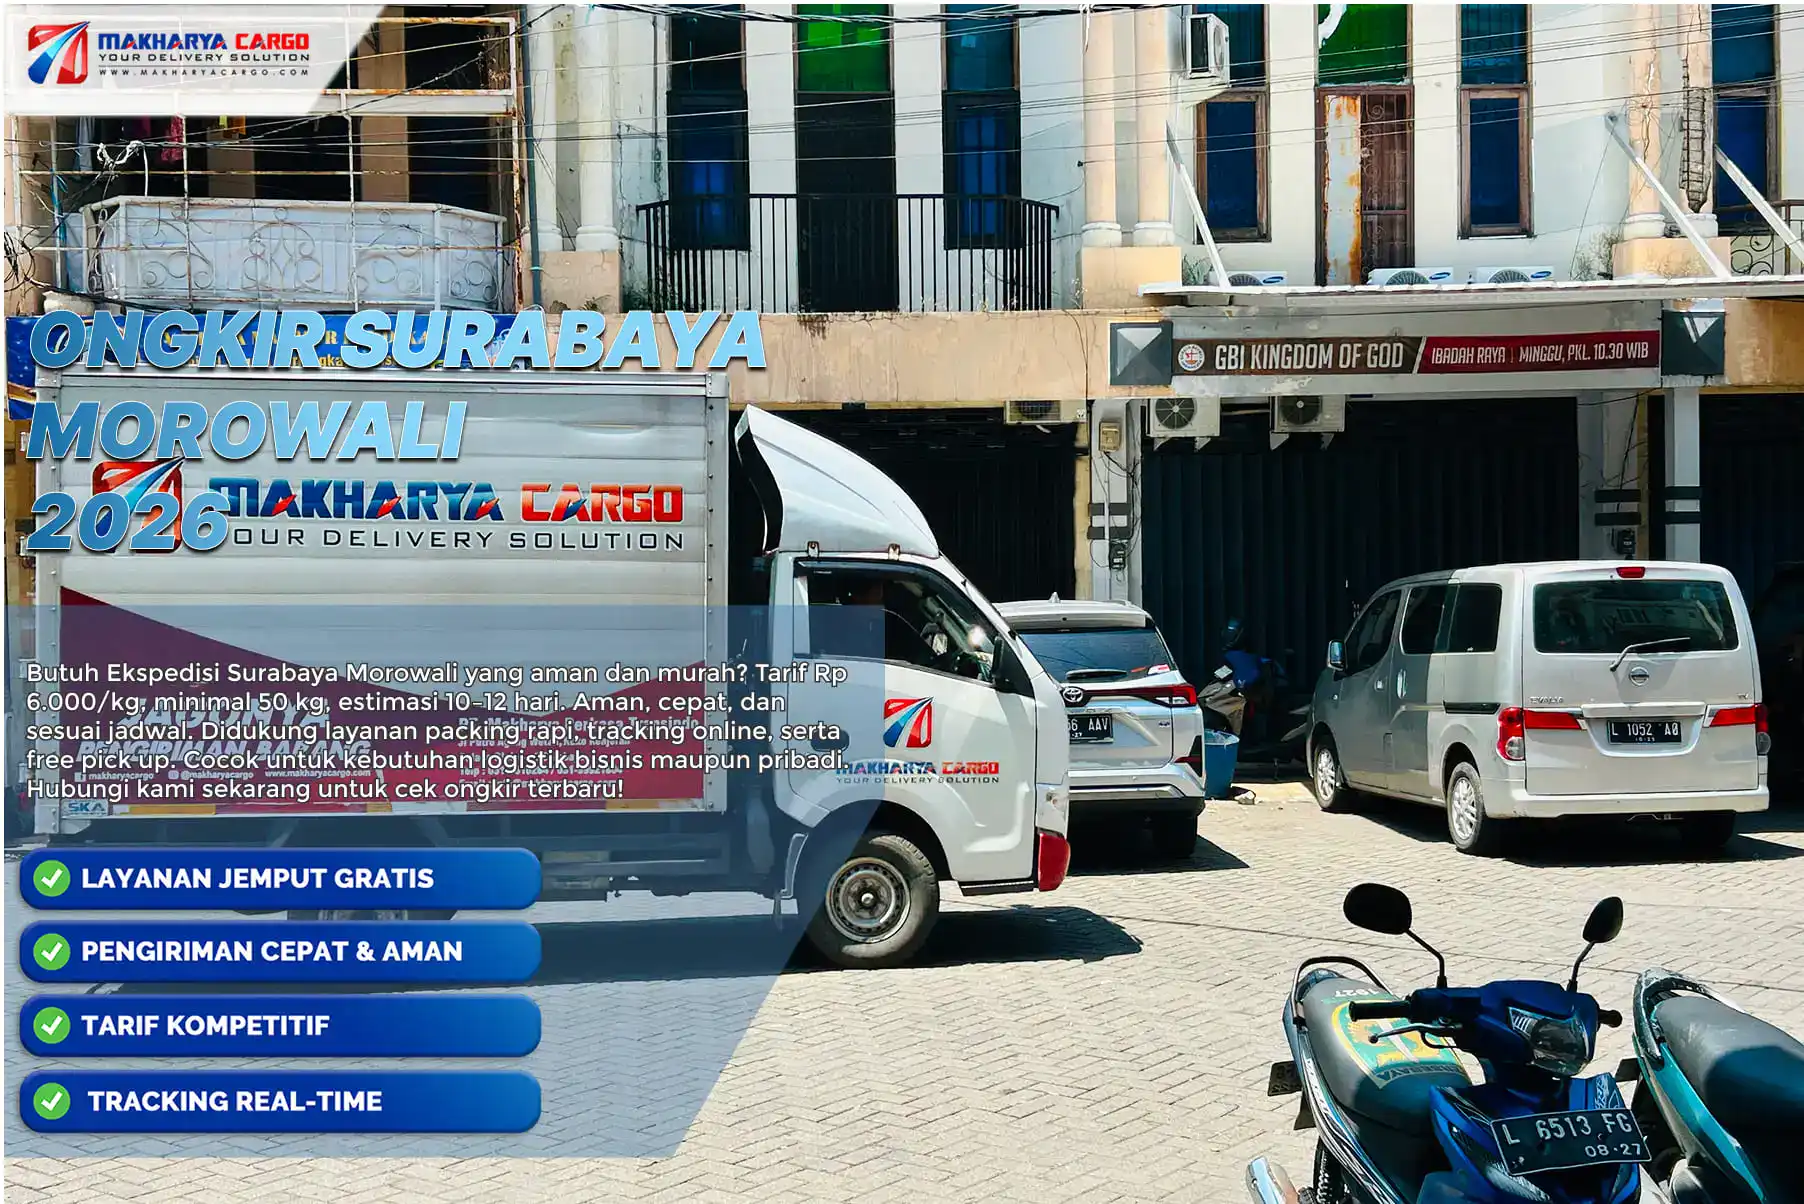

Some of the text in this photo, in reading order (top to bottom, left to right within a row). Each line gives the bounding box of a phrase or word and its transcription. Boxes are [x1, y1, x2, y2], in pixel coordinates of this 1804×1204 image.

[1215, 344, 1245, 370] GBI
[1251, 344, 1332, 370] KINGDOM
[1338, 343, 1363, 368] OF
[1366, 342, 1405, 368] GOD
[1431, 341, 1650, 364] IBADAH RAYA MINGGU, PKL. 10.30 WIB
[208, 477, 684, 522] MAKHARYA CARGO
[233, 528, 684, 549] OUR DELIVERY SOLUTION
[1088, 717, 1109, 731] AAV
[1611, 723, 1619, 736] L
[1626, 722, 1654, 736] 1052
[942, 761, 1000, 775] CARGO
[1501, 1123, 1521, 1146] L
[1535, 1116, 1593, 1141] 6513
